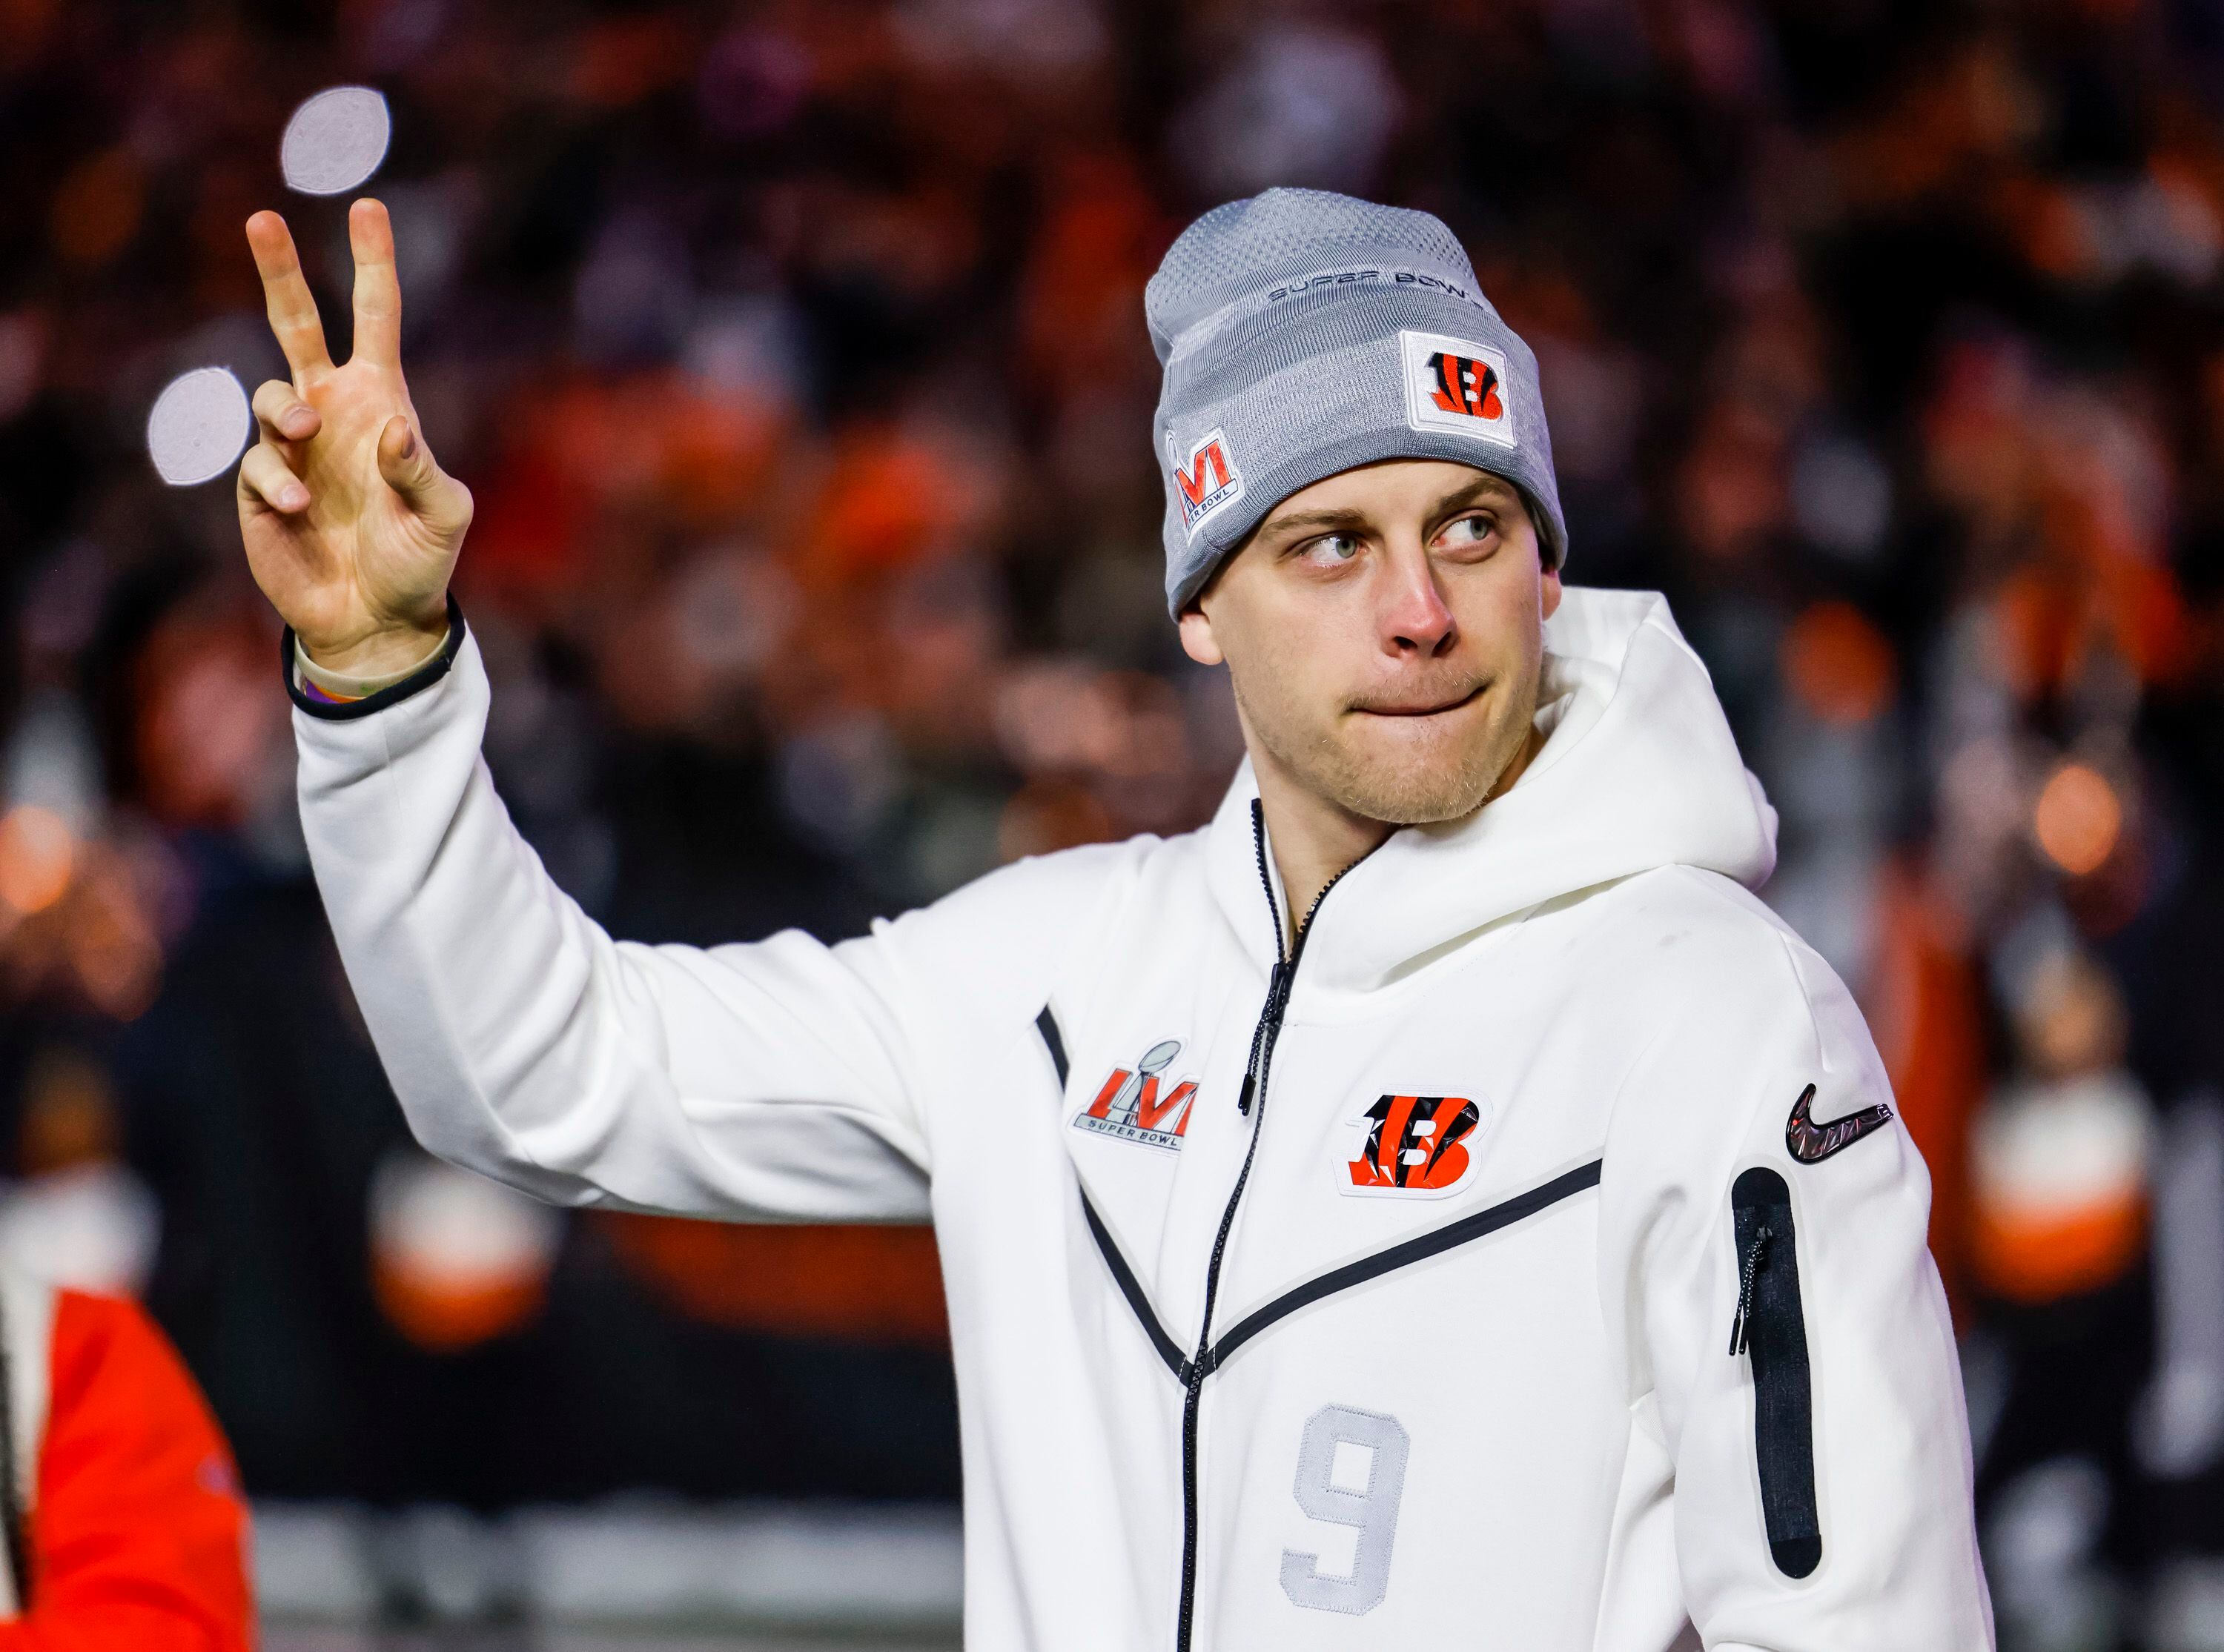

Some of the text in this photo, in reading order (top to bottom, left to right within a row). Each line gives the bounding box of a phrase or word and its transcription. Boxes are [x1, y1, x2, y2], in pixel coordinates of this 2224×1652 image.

[1175, 438, 1232, 528] VI
[1201, 488, 1230, 511] BOWL
[1088, 1120, 1177, 1147] SUPER BOWL
[1280, 1402, 1410, 1616] 9
